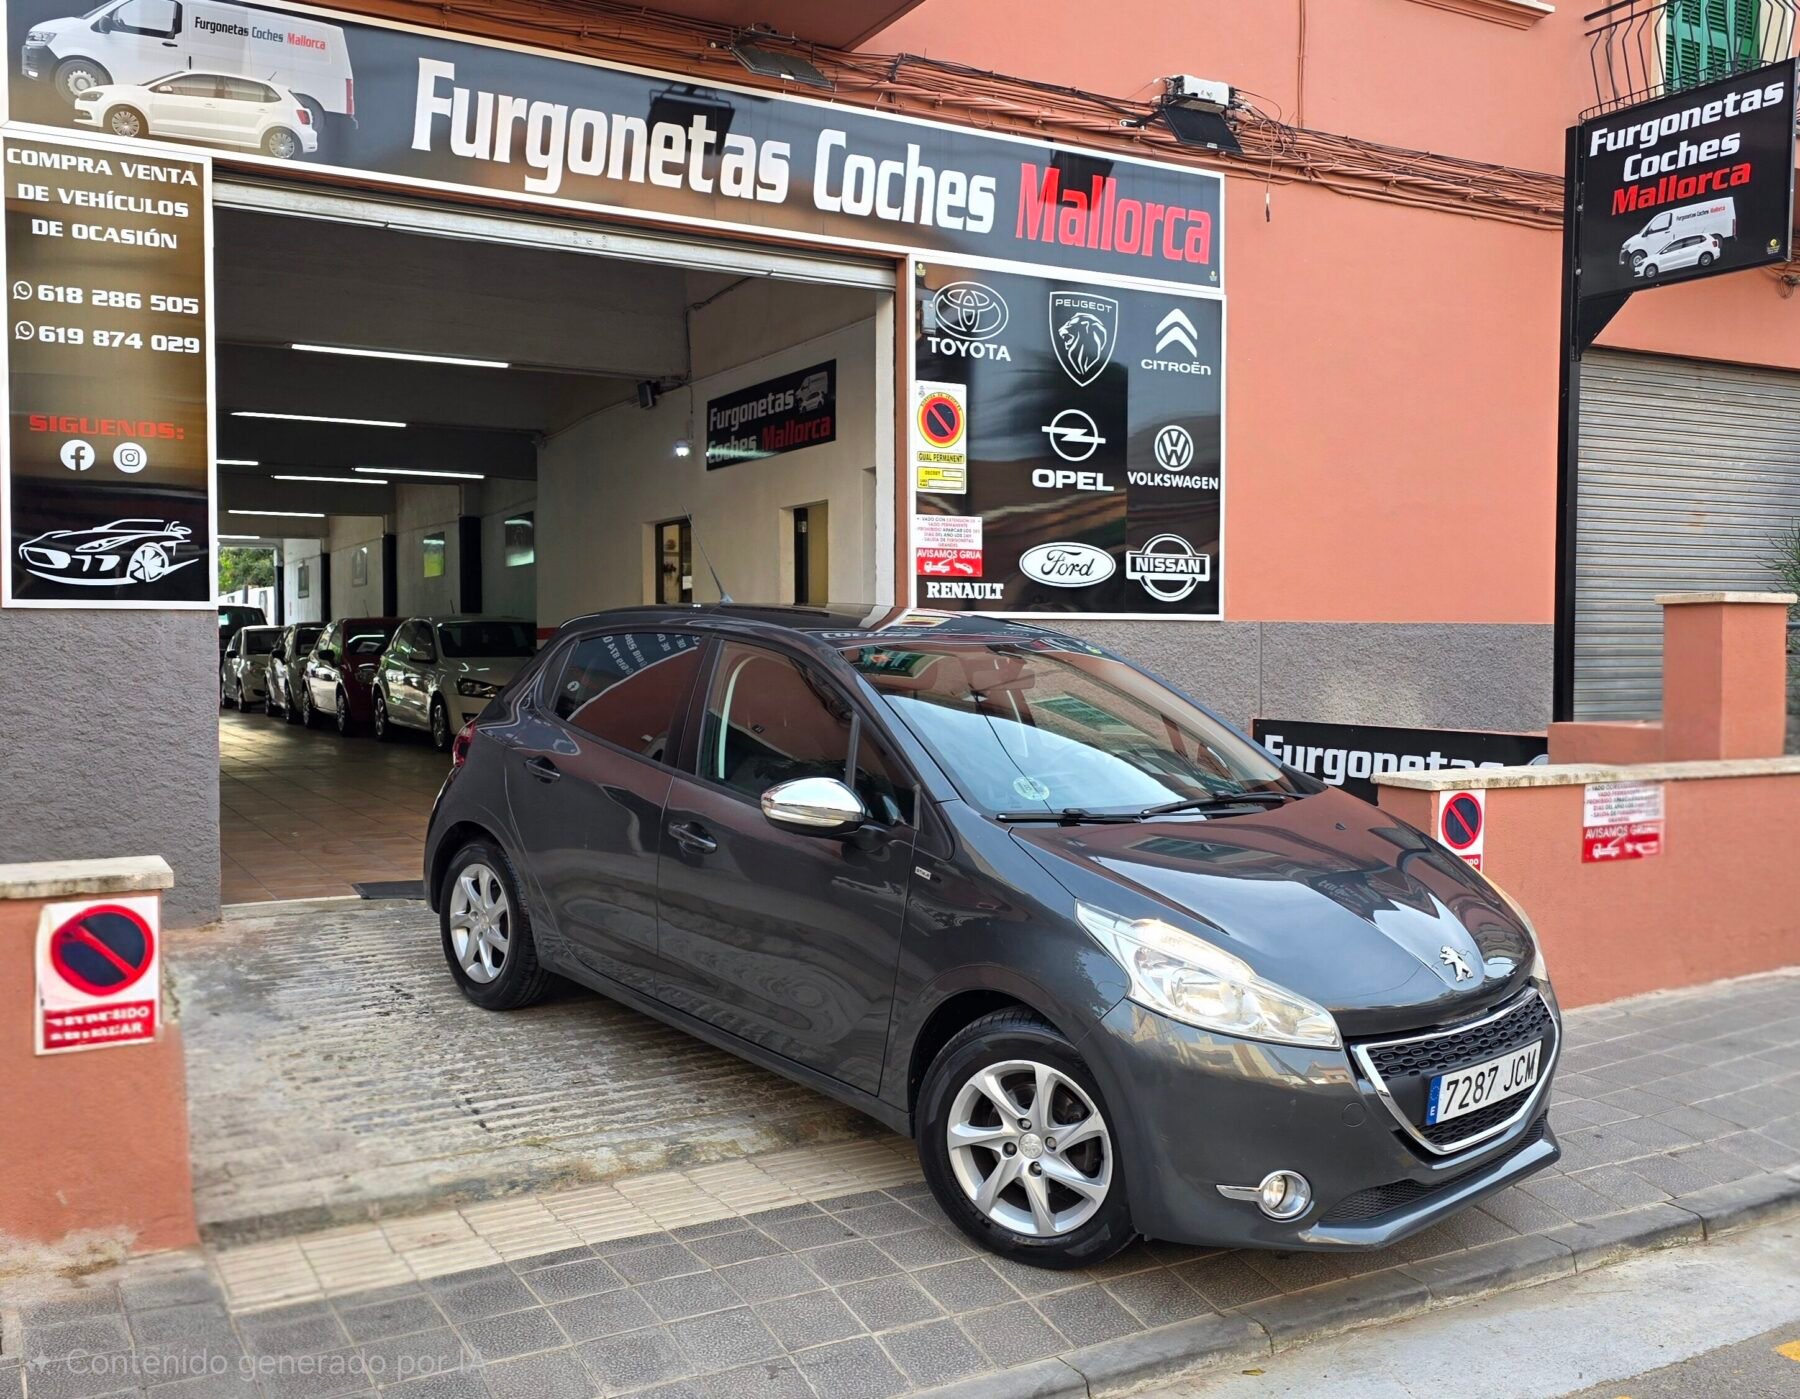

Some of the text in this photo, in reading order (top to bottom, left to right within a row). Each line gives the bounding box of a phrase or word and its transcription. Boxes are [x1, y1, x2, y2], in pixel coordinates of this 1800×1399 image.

[195, 16, 326, 51] Furgonetas Coches Mallorca
[1589, 81, 1784, 157] Furgonetas
[7, 148, 198, 186] COMPRA VENTA
[411, 57, 1211, 265] Furgonetas Coches Mallorca
[1623, 132, 1741, 182] Coches
[17, 183, 189, 218] DE VEHÍCULOS
[1611, 162, 1752, 216] Mallorca
[31, 219, 177, 249] DE OCASIÓN
[37, 285, 199, 314] 618 286 505
[1055, 299, 1113, 313] PEUGEOT
[38, 326, 200, 354] 619 874 029
[927, 336, 1011, 362] TOYOTA
[1140, 359, 1211, 376] CITROËN
[709, 389, 795, 432] Furgonetas
[29, 412, 185, 440] SIGUENOS:
[708, 416, 831, 463] Coches Mallorca
[919, 453, 963, 463] GUAL PERMANENT
[1032, 469, 1115, 491] OPEL
[1127, 471, 1219, 490] VOLKSWAGEN
[917, 549, 982, 559] AVISAMOS GRUA
[1041, 549, 1095, 577] Ford
[1136, 558, 1200, 574] NISSAN
[926, 582, 1004, 600] RENAULT
[1265, 734, 1504, 786] Furgonet
[1585, 824, 1628, 839] AVISAMOS
[1444, 1049, 1536, 1114] 7287 JCM
[1430, 1105, 1436, 1116] E
